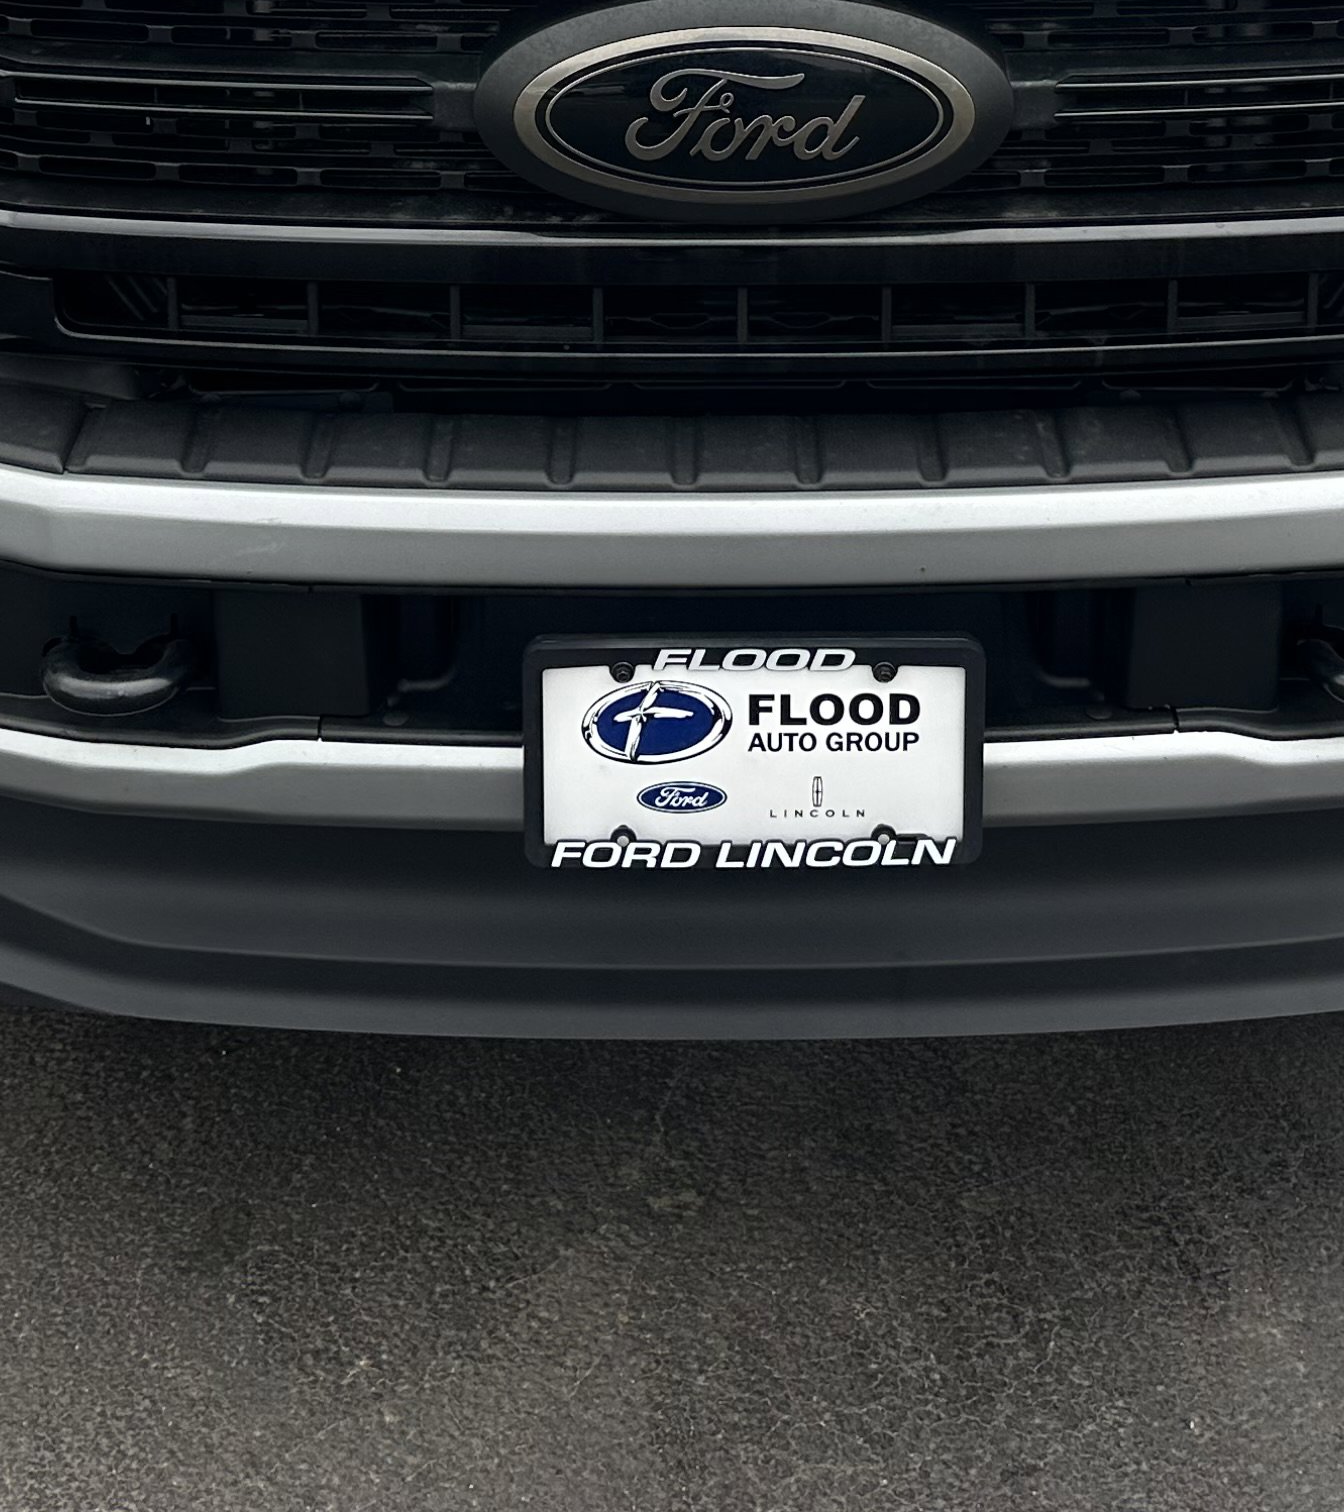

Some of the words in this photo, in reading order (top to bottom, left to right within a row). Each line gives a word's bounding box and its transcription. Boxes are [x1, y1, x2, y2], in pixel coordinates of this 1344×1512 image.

[624, 68, 867, 161] Ford
[653, 648, 857, 672] FLOOD
[748, 693, 921, 726] FLOOD
[748, 732, 817, 752] AUTO
[825, 731, 921, 753] GROUP
[654, 787, 709, 809] Ford
[769, 808, 866, 819] LINCOLN
[551, 841, 702, 868] FORD
[715, 838, 957, 867] LINCOLN
